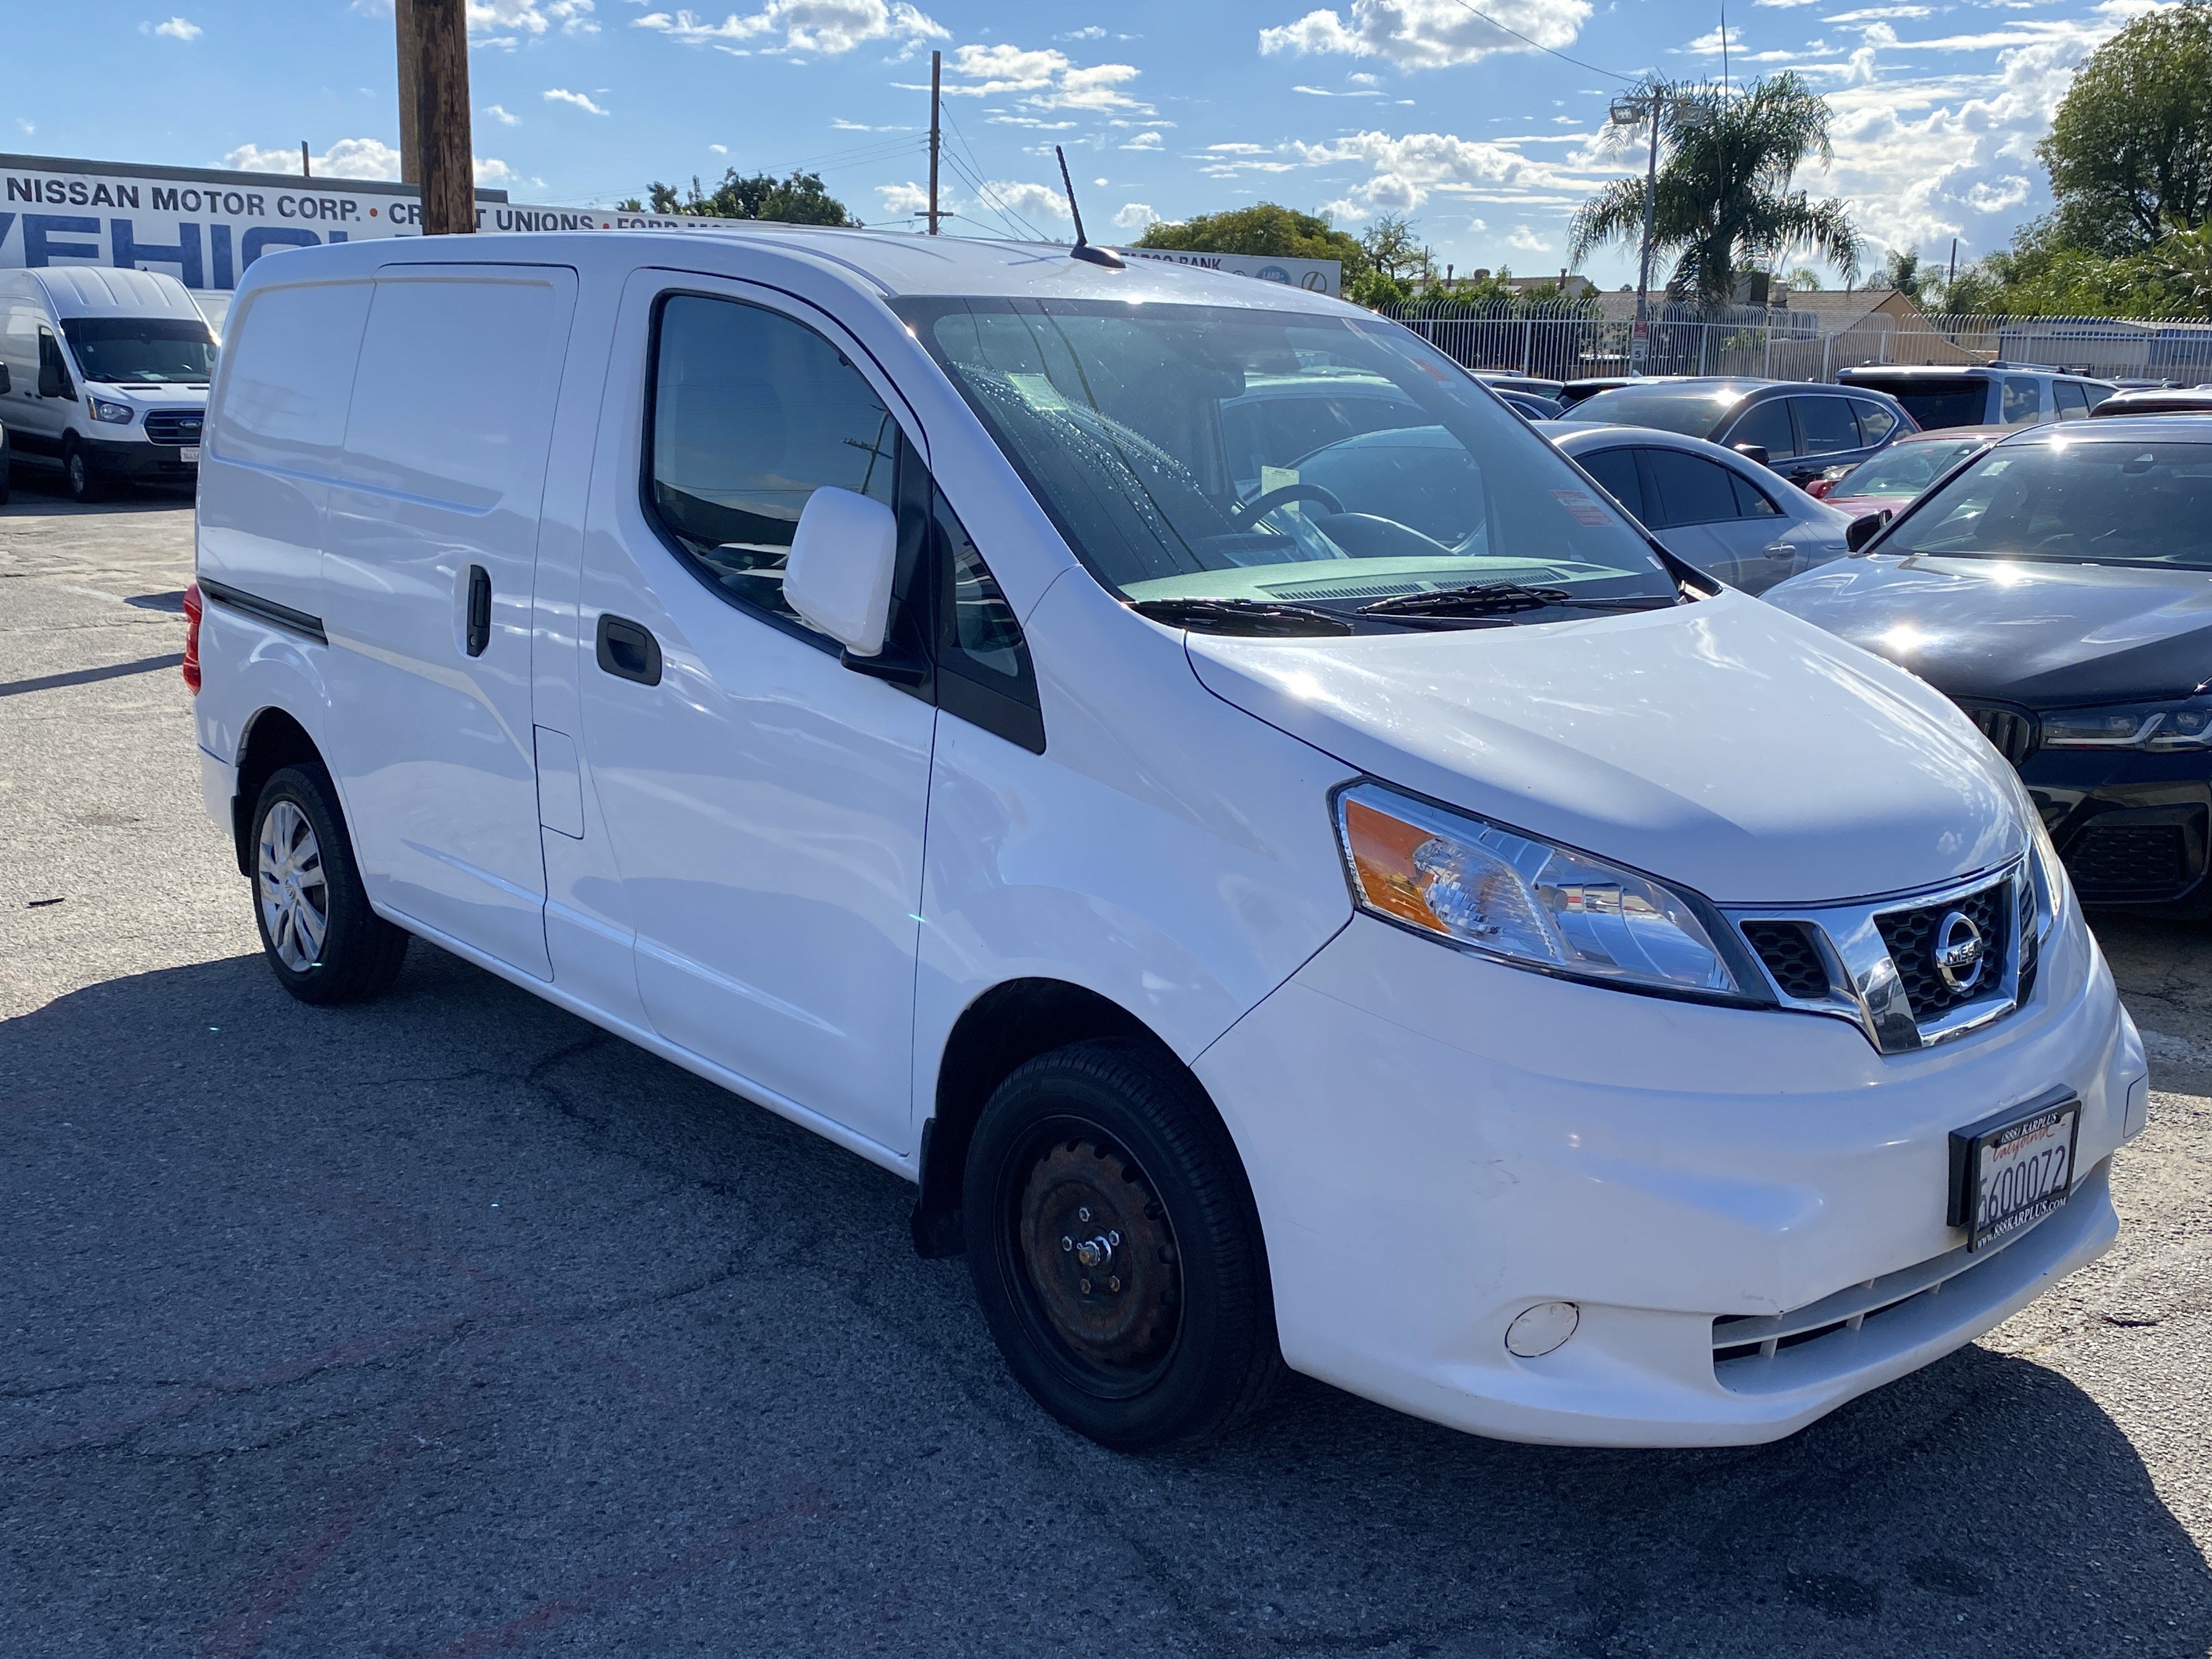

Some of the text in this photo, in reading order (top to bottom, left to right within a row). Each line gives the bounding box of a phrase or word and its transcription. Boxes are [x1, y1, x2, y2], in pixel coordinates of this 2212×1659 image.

[7, 177, 139, 208] NISSAN
[151, 187, 266, 216] MOTOR
[277, 195, 360, 222] CORP.
[388, 202, 486, 228] CRT
[496, 209, 594, 231] UNIONS
[1180, 256, 1222, 271] BANK
[2021, 1111, 2058, 1137] KARPLUS
